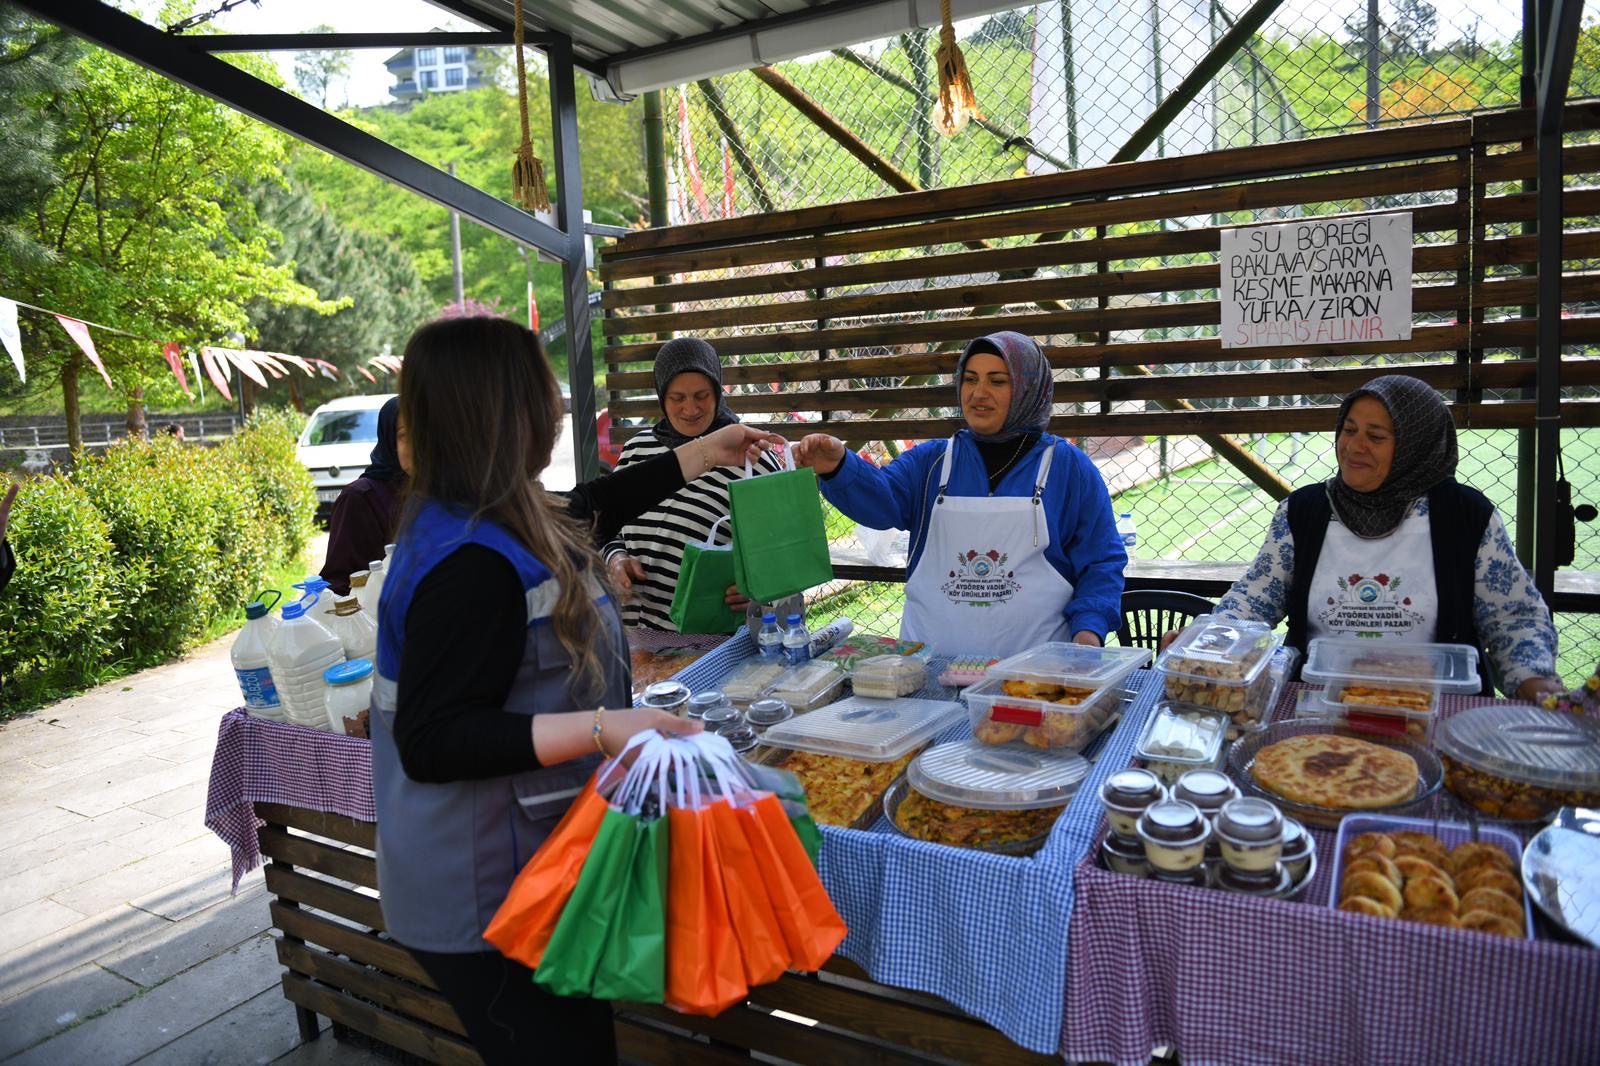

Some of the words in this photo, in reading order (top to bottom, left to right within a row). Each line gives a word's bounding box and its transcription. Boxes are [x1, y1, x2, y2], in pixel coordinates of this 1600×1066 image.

[1249, 230, 1281, 253] SU
[1297, 218, 1371, 251] BÖREĞİ
[1233, 275, 1304, 301] KESME
[1310, 268, 1393, 297] MAKARNA
[1316, 315, 1384, 342] ALINIR
[992, 590, 1012, 598] PAZARI
[1328, 619, 1344, 627] KÖY
[1345, 619, 1383, 628] ÜRÜNLERİ
[1384, 620, 1412, 628] PAZARI
[1337, 610, 1374, 619] AYGÖREN
[1376, 610, 1402, 619] VADİSİ
